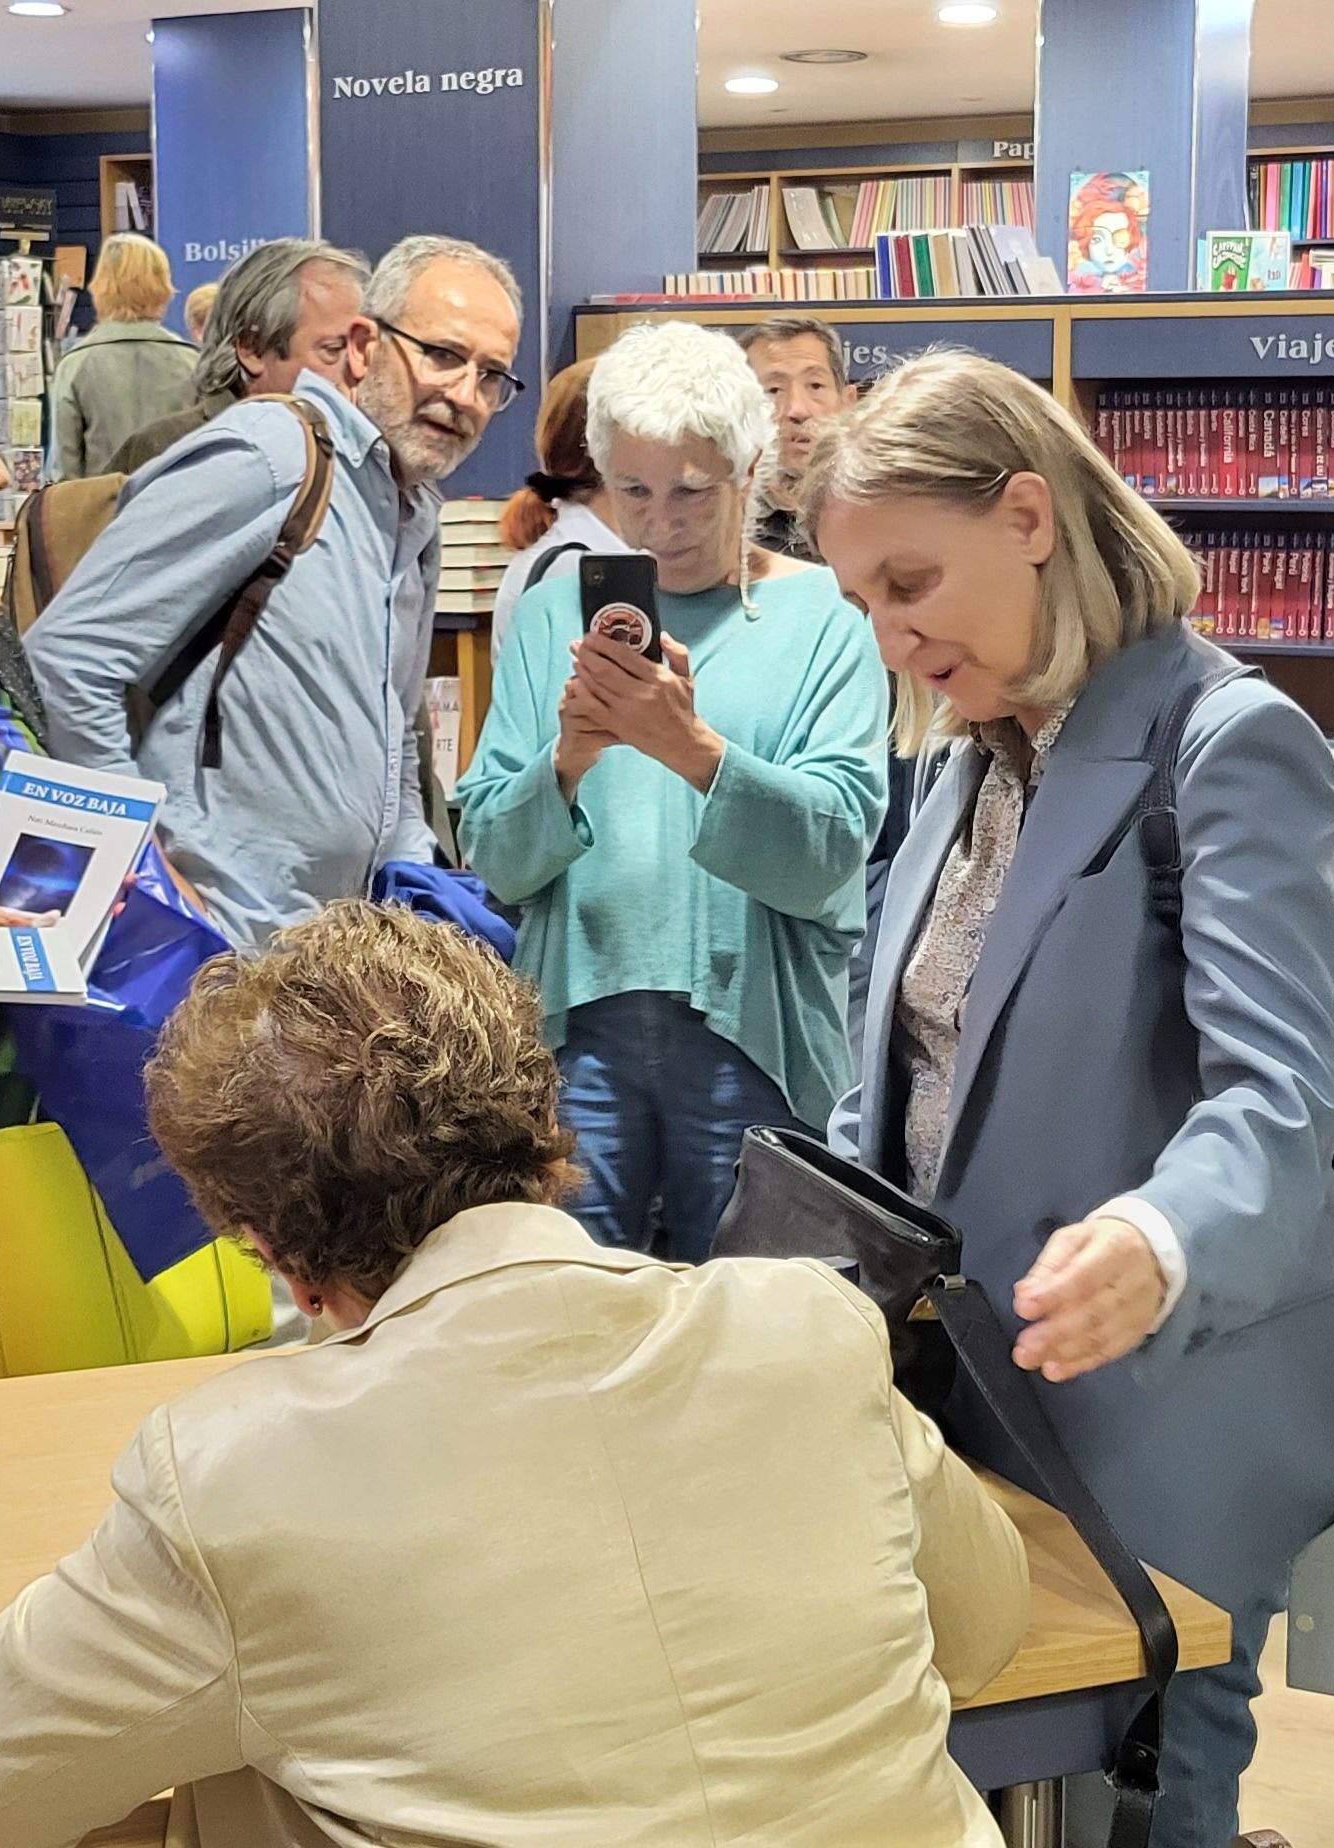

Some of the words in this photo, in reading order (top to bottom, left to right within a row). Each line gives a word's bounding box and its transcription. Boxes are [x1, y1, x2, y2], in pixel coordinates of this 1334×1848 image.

[333, 71, 431, 99] Novela
[440, 67, 523, 96] negra
[185, 238, 267, 262] Bolsi
[1223, 410, 1234, 464] California
[1263, 410, 1276, 458] Canadá
[1301, 410, 1310, 437] Corea
[1274, 552, 1286, 589] Portugal
[22, 781, 49, 798] EN
[51, 790, 86, 808] VOZ
[87, 798, 128, 816] BAJA
